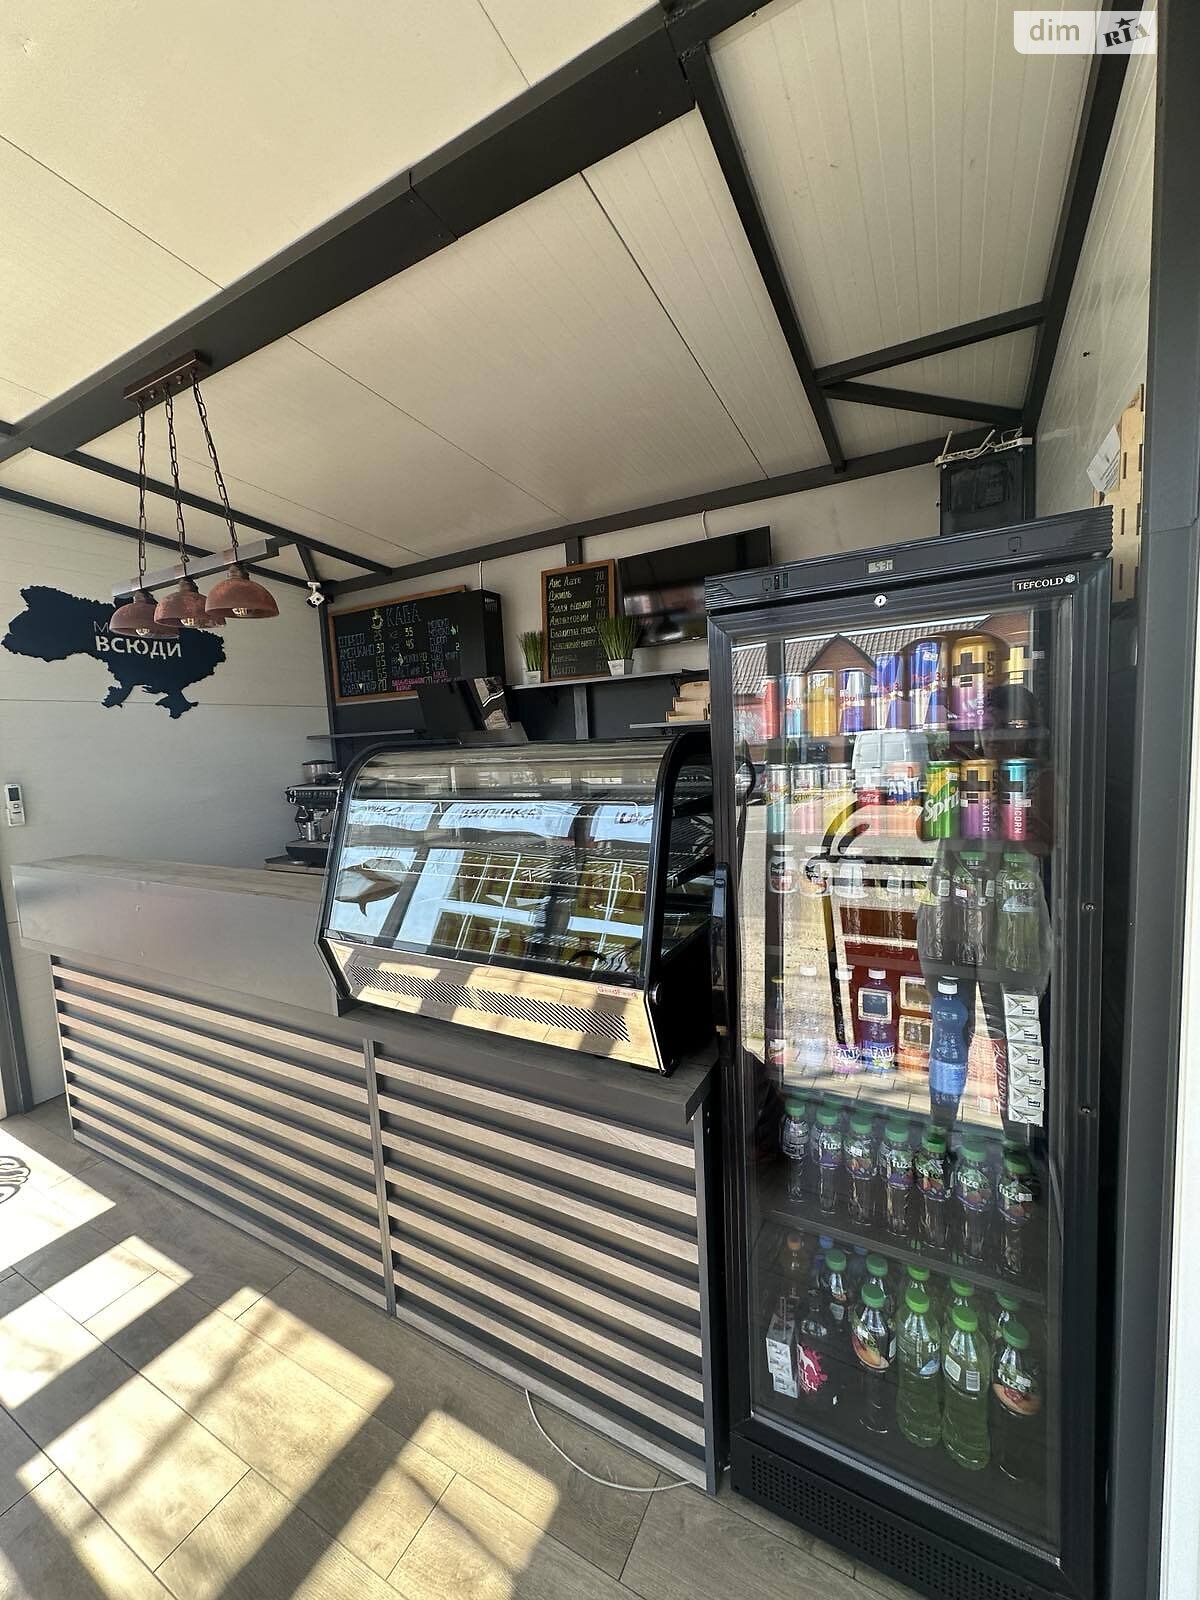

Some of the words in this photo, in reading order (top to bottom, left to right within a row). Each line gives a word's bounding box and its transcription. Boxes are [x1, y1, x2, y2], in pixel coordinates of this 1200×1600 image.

[1016, 577, 1064, 591] TEFCOLD
[95, 635, 183, 660] ВСЮДИ
[982, 798, 991, 832] EXOTIC
